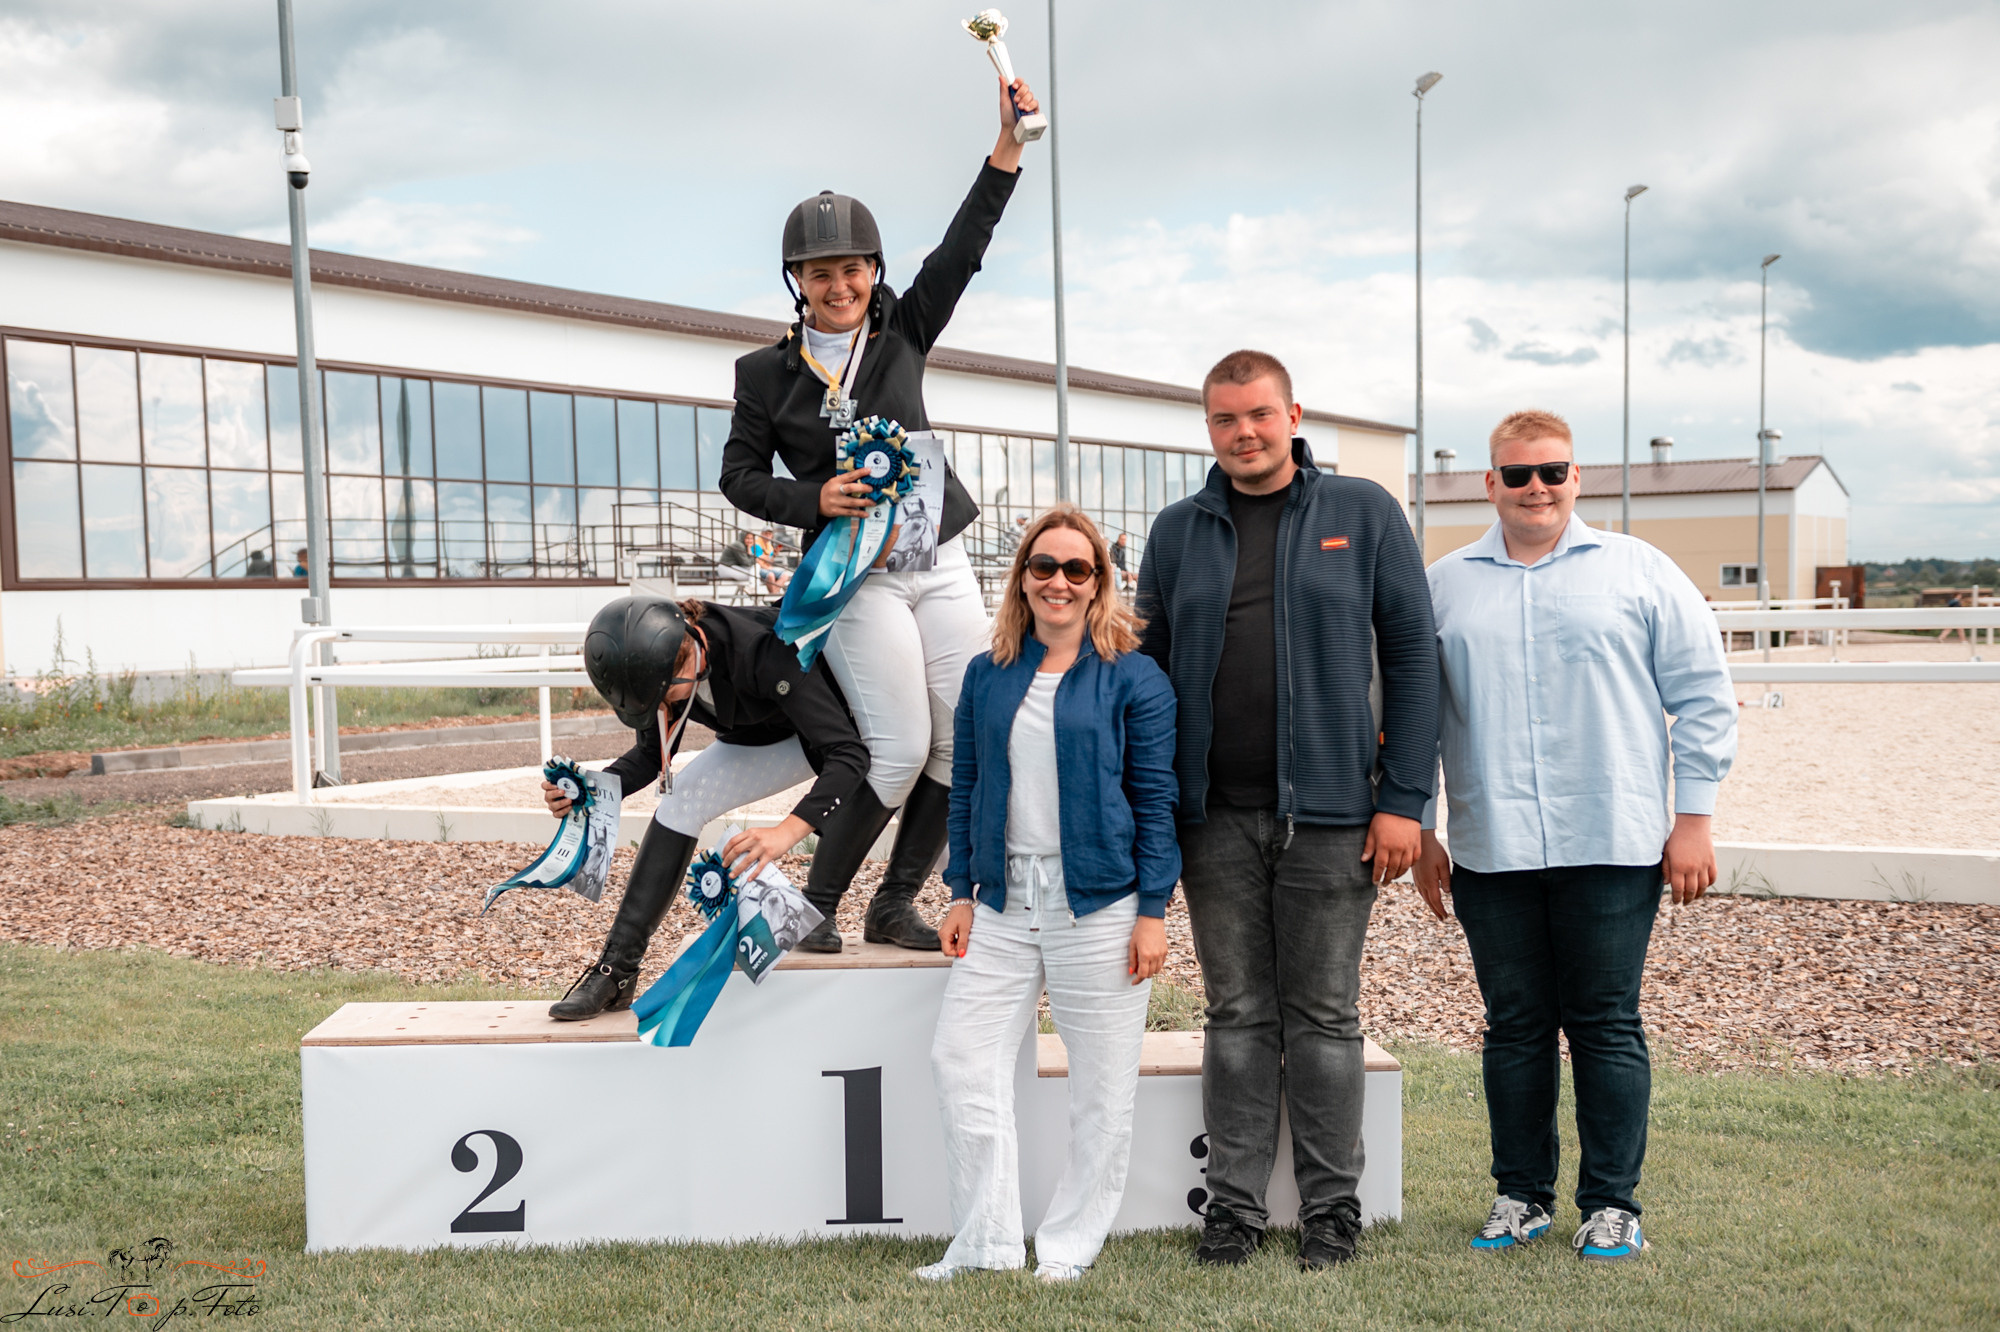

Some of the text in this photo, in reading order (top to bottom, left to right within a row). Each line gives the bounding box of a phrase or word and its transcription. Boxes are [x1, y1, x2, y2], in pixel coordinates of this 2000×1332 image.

[1772, 692, 1781, 708] 2
[738, 935, 763, 965] 2
[821, 1066, 903, 1225] 1
[450, 1129, 526, 1233] 2
